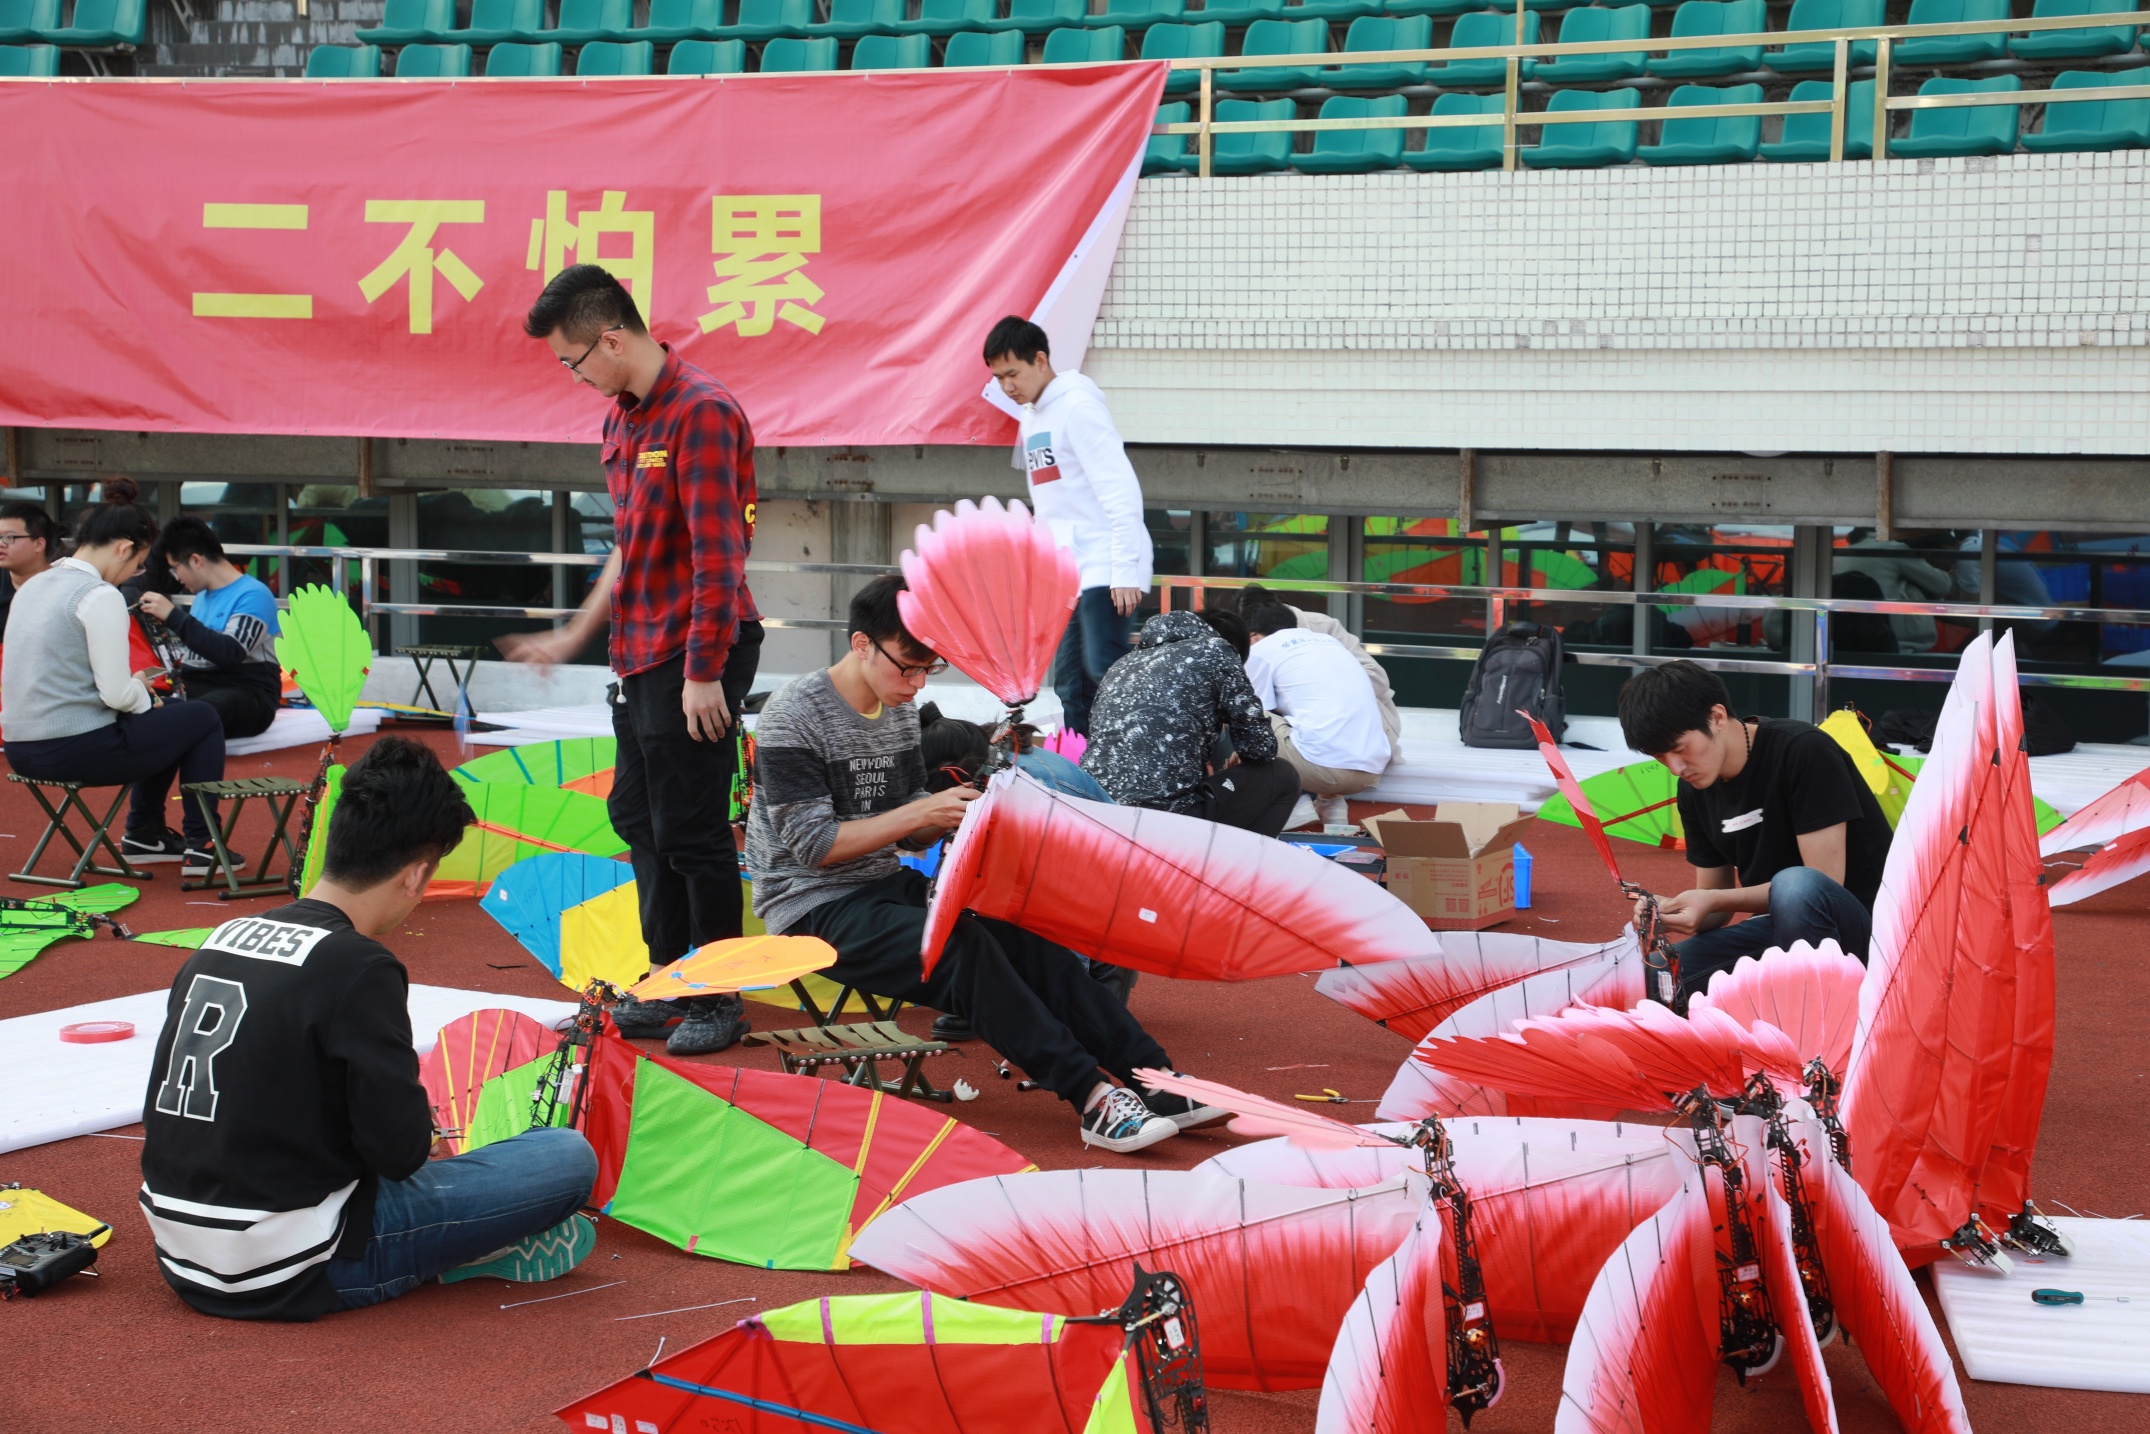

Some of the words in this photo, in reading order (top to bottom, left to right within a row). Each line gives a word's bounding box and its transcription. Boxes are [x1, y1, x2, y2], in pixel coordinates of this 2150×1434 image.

[192, 189, 826, 337] 二不怕累
[853, 785, 887, 800] PARIS
[854, 772, 888, 786] SEOUL
[213, 919, 314, 958] VIBES
[155, 973, 248, 1122] R
